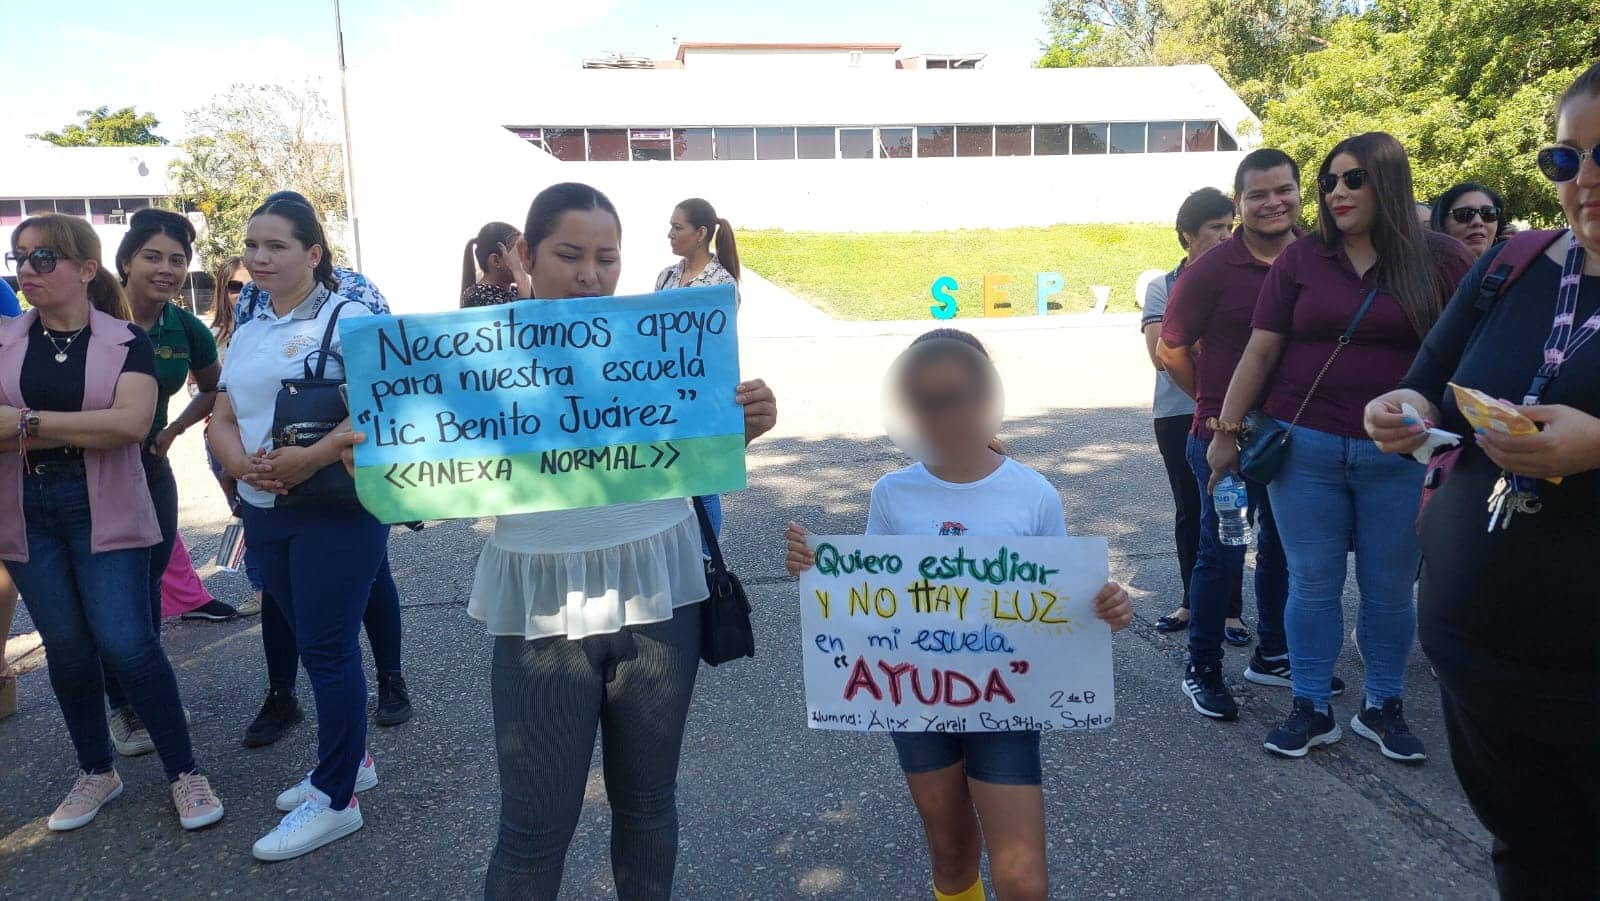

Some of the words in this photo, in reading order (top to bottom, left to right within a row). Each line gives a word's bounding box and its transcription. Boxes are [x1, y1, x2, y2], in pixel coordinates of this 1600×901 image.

[378, 309, 612, 370] Necesitamos
[637, 308, 727, 356] apoyo
[371, 376, 443, 412] para
[460, 359, 574, 391] nuestra
[602, 347, 706, 382] escuela
[438, 402, 541, 443] Benito
[559, 389, 697, 435] Juárez"
[383, 458, 512, 489] <<ANEXA
[541, 441, 681, 475] NORMAL>>
[814, 542, 903, 577] Quiero
[918, 546, 1059, 584] estudiar
[815, 589, 831, 619] Y
[849, 581, 897, 619] NO
[907, 579, 970, 621] HAY
[993, 588, 1070, 624] LUZ
[814, 634, 845, 652] en
[867, 627, 901, 651] mi
[834, 655, 1029, 706] "AYUDA"
[1050, 690, 1064, 708] 2
[1060, 711, 1112, 729] Sotelo
